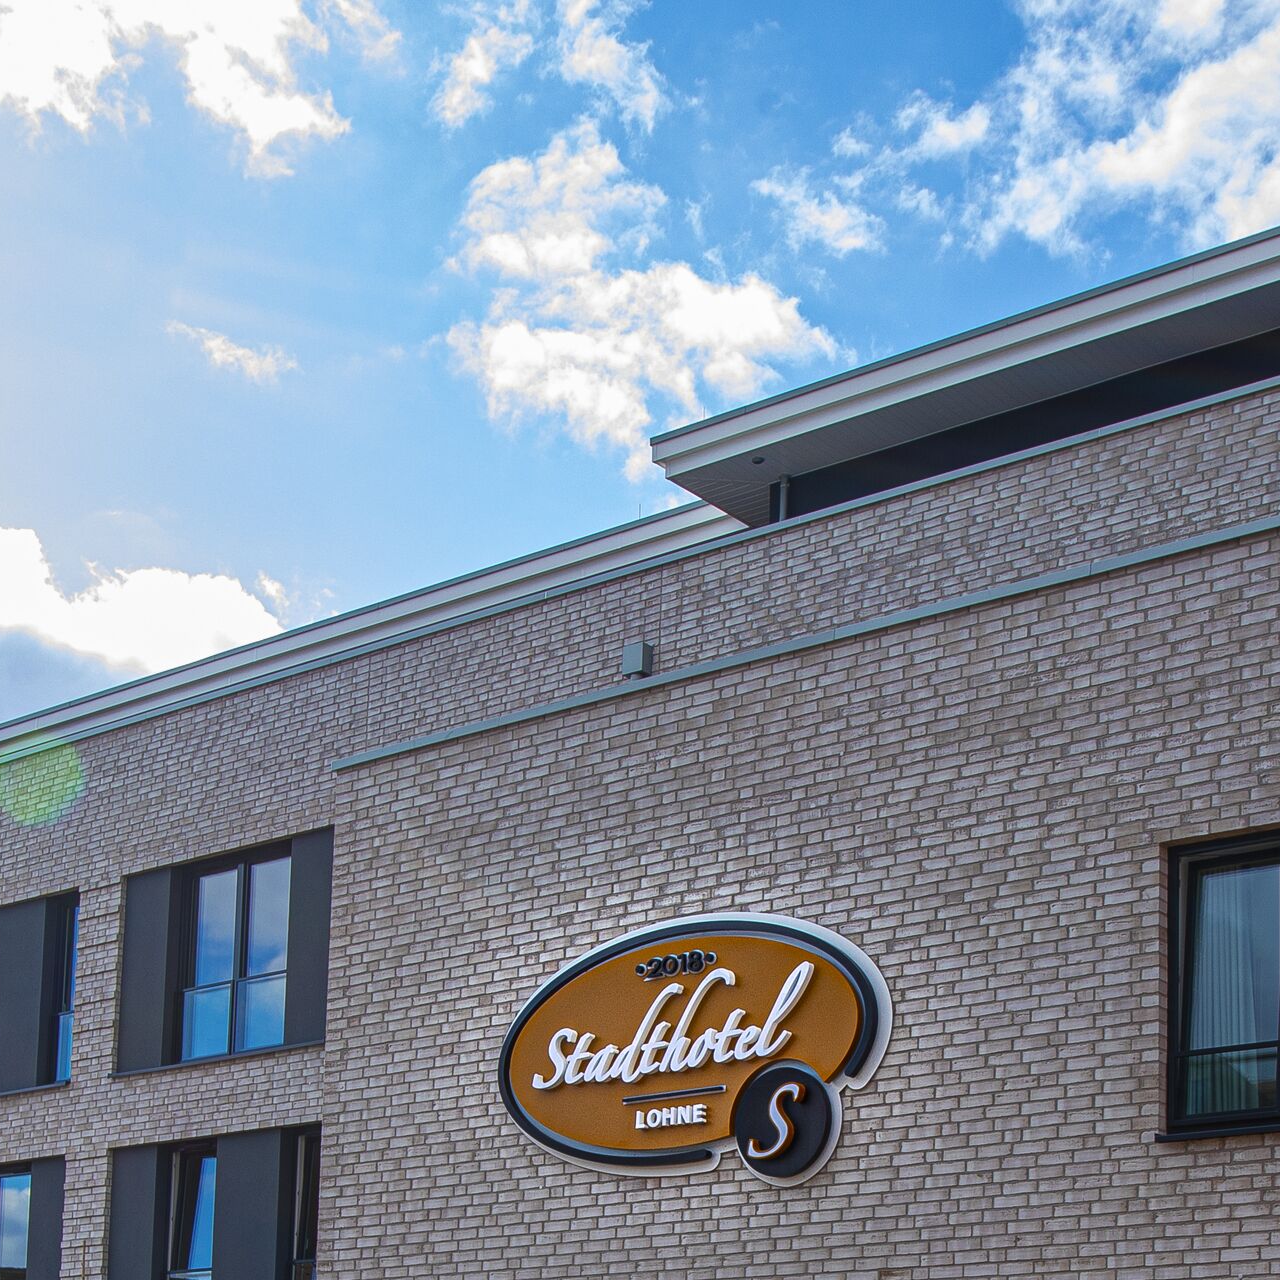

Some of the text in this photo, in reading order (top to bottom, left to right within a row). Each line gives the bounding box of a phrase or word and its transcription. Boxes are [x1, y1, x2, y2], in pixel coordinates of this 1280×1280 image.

[645, 951, 706, 981] 2018
[532, 960, 815, 1091] Stadthotel
[634, 1103, 708, 1131] LOHNE
[747, 1081, 806, 1160] S
